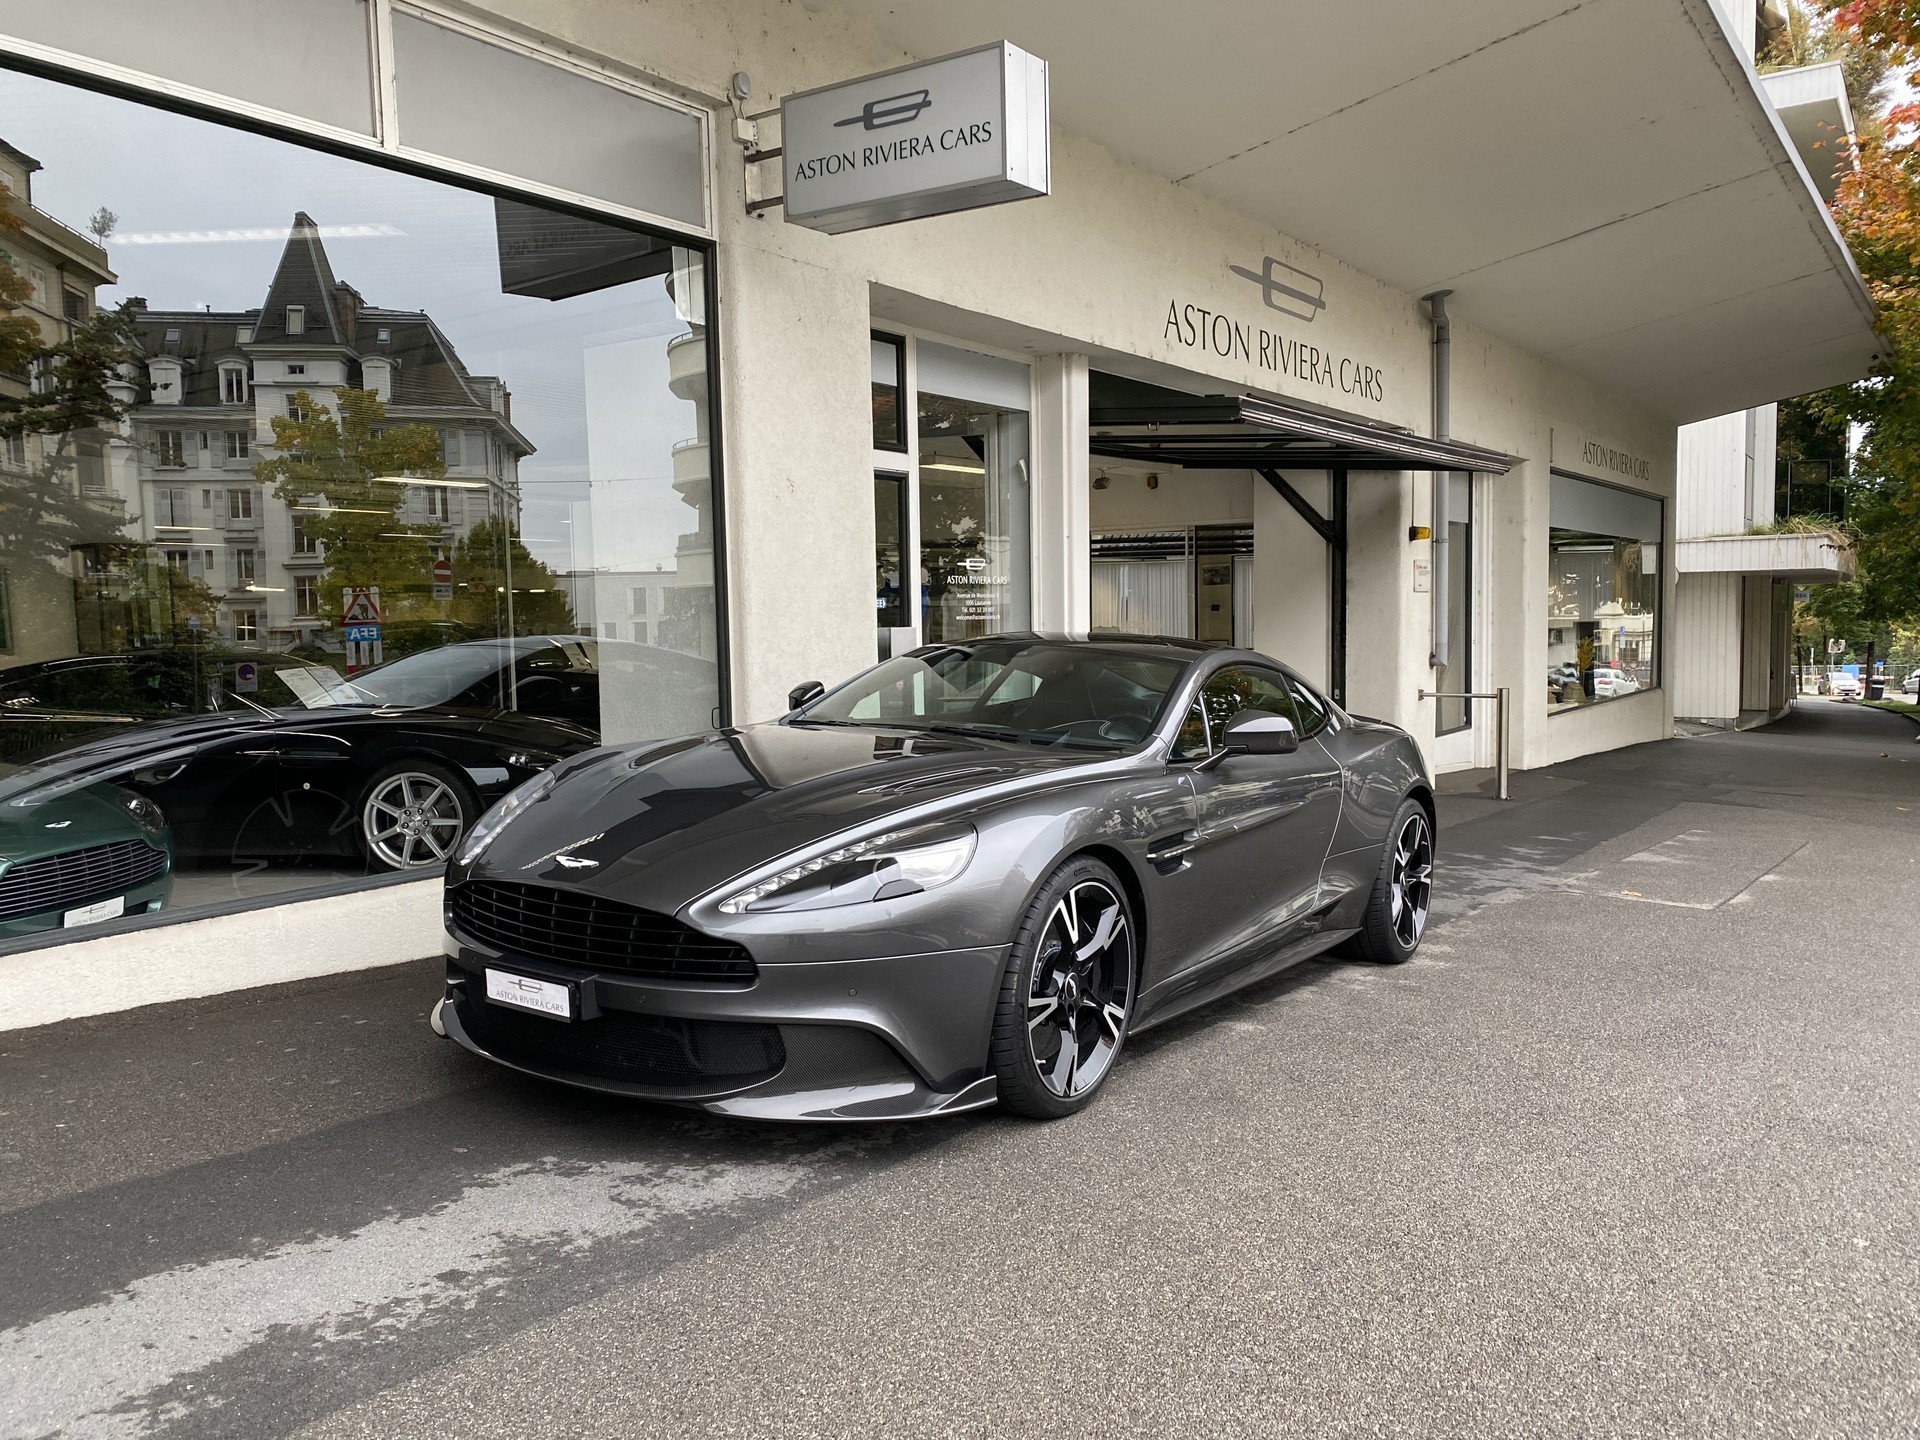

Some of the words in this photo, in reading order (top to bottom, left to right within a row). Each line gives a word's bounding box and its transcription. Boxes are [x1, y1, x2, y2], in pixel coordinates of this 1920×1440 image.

[795, 151, 856, 181] ASTON
[863, 135, 935, 167] RIVIERA
[940, 121, 992, 151] CARS
[1163, 298, 1251, 363] ASTON
[1259, 329, 1334, 389] RIVIERA
[1340, 358, 1384, 403] CARS
[1582, 441, 1608, 468] ASTON
[1609, 449, 1633, 476] RIVIERA
[1634, 457, 1649, 481] CARS
[947, 575, 968, 584] ASTON
[969, 575, 992, 584] RIVIERA
[992, 575, 1008, 584] CARS
[496, 990, 518, 1001] ASTON
[520, 995, 544, 1008] RIVIERA
[545, 1001, 564, 1012] CARS
